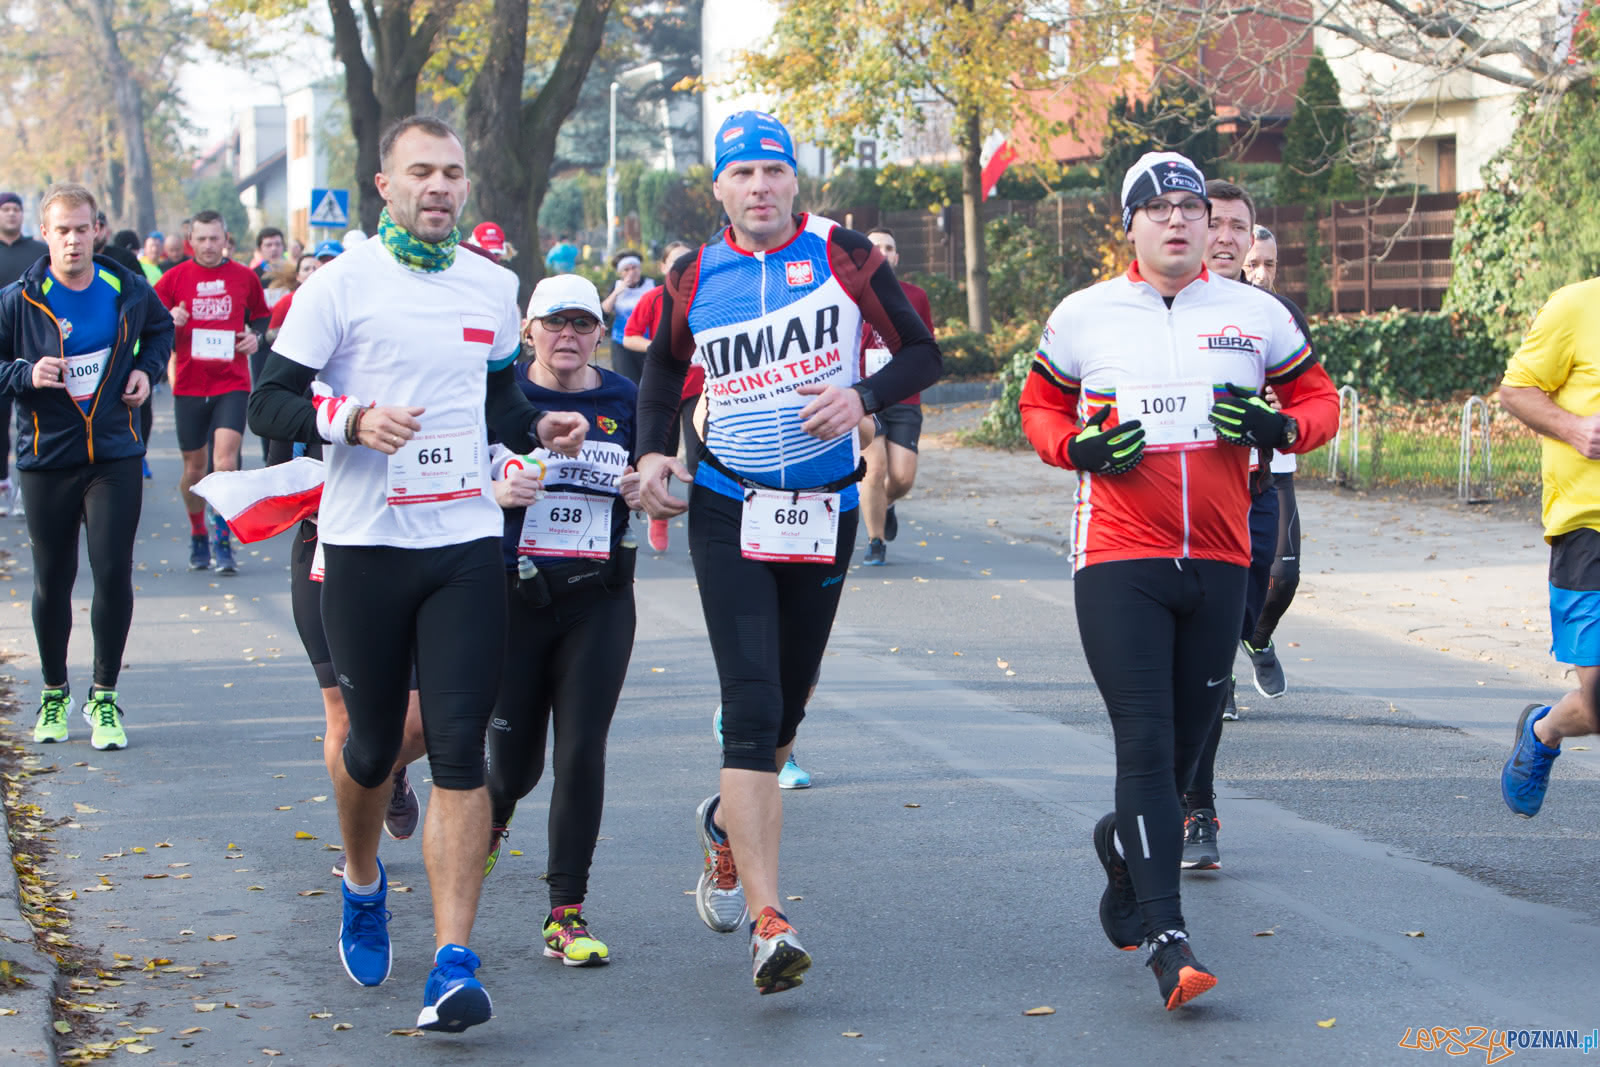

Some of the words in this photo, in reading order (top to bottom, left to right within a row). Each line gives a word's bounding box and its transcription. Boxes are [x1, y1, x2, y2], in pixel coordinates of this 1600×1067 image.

[1208, 337, 1254, 352] LIBRA
[69, 362, 99, 378] 1008
[711, 368, 782, 397] RACING
[784, 347, 841, 378] TEAM
[733, 393, 767, 405] YOUR
[1141, 396, 1186, 415] 1007
[418, 447, 453, 465] 661
[550, 507, 582, 523] 638
[775, 508, 809, 525] 680
